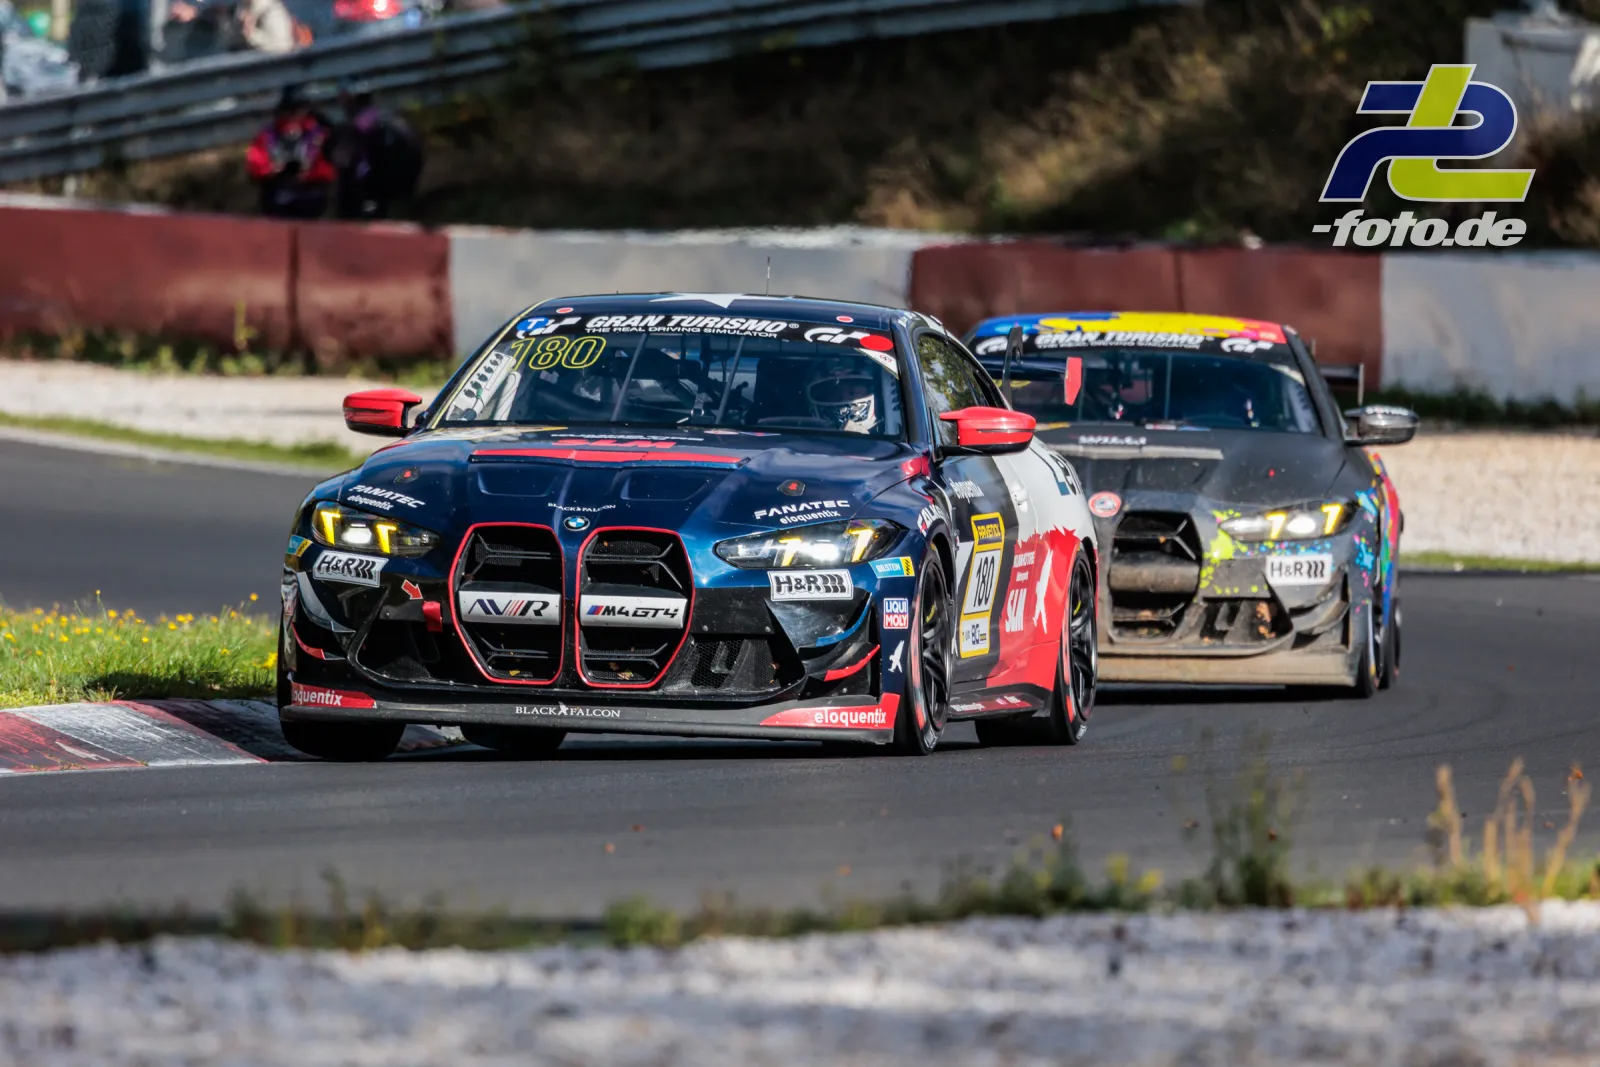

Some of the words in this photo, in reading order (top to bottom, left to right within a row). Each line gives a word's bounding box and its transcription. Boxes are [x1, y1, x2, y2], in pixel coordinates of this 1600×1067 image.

[586, 315, 665, 329] GRAN
[703, 328, 778, 339] SIMULATOR
[511, 335, 607, 370] 180
[348, 484, 426, 508] FANATEC
[547, 502, 576, 512] BLACK
[754, 500, 851, 515] FANATEC
[779, 505, 841, 525] eloquentix
[317, 554, 357, 577] H&R
[1271, 561, 1304, 578] H&R
[774, 574, 822, 595] H&R
[973, 555, 995, 608] 180
[885, 601, 908, 614] LIQUI
[884, 614, 908, 628] MOLY
[515, 706, 557, 716] BLACK
[569, 707, 621, 718] FALCON
[814, 708, 887, 727] eloquentix
